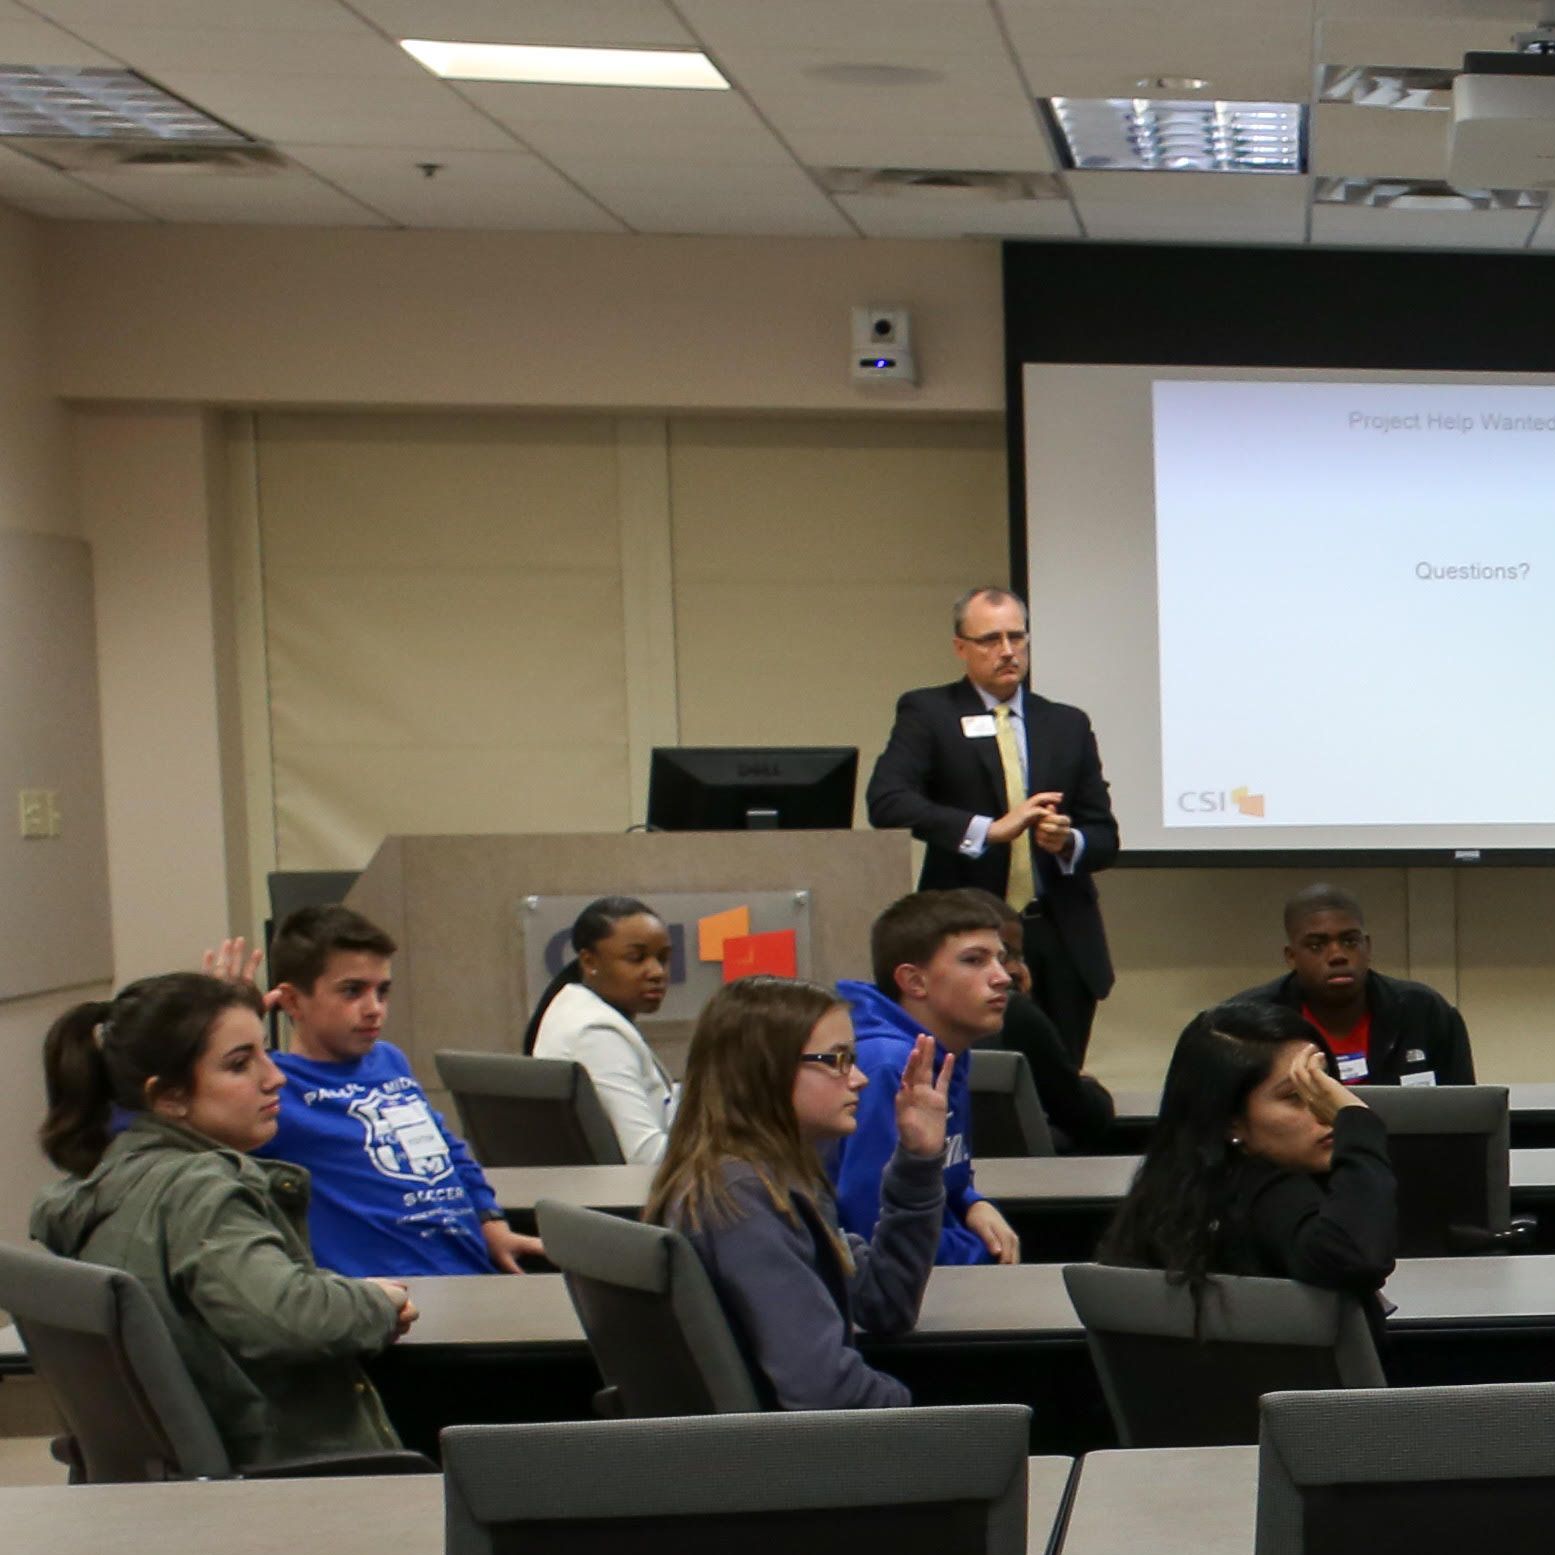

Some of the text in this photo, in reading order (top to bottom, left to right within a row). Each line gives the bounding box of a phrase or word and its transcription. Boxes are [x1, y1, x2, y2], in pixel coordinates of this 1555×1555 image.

[1348, 410, 1421, 434] Project
[1426, 412, 1475, 435] Help
[1415, 561, 1531, 581] Questions?
[1178, 791, 1225, 812] CSI
